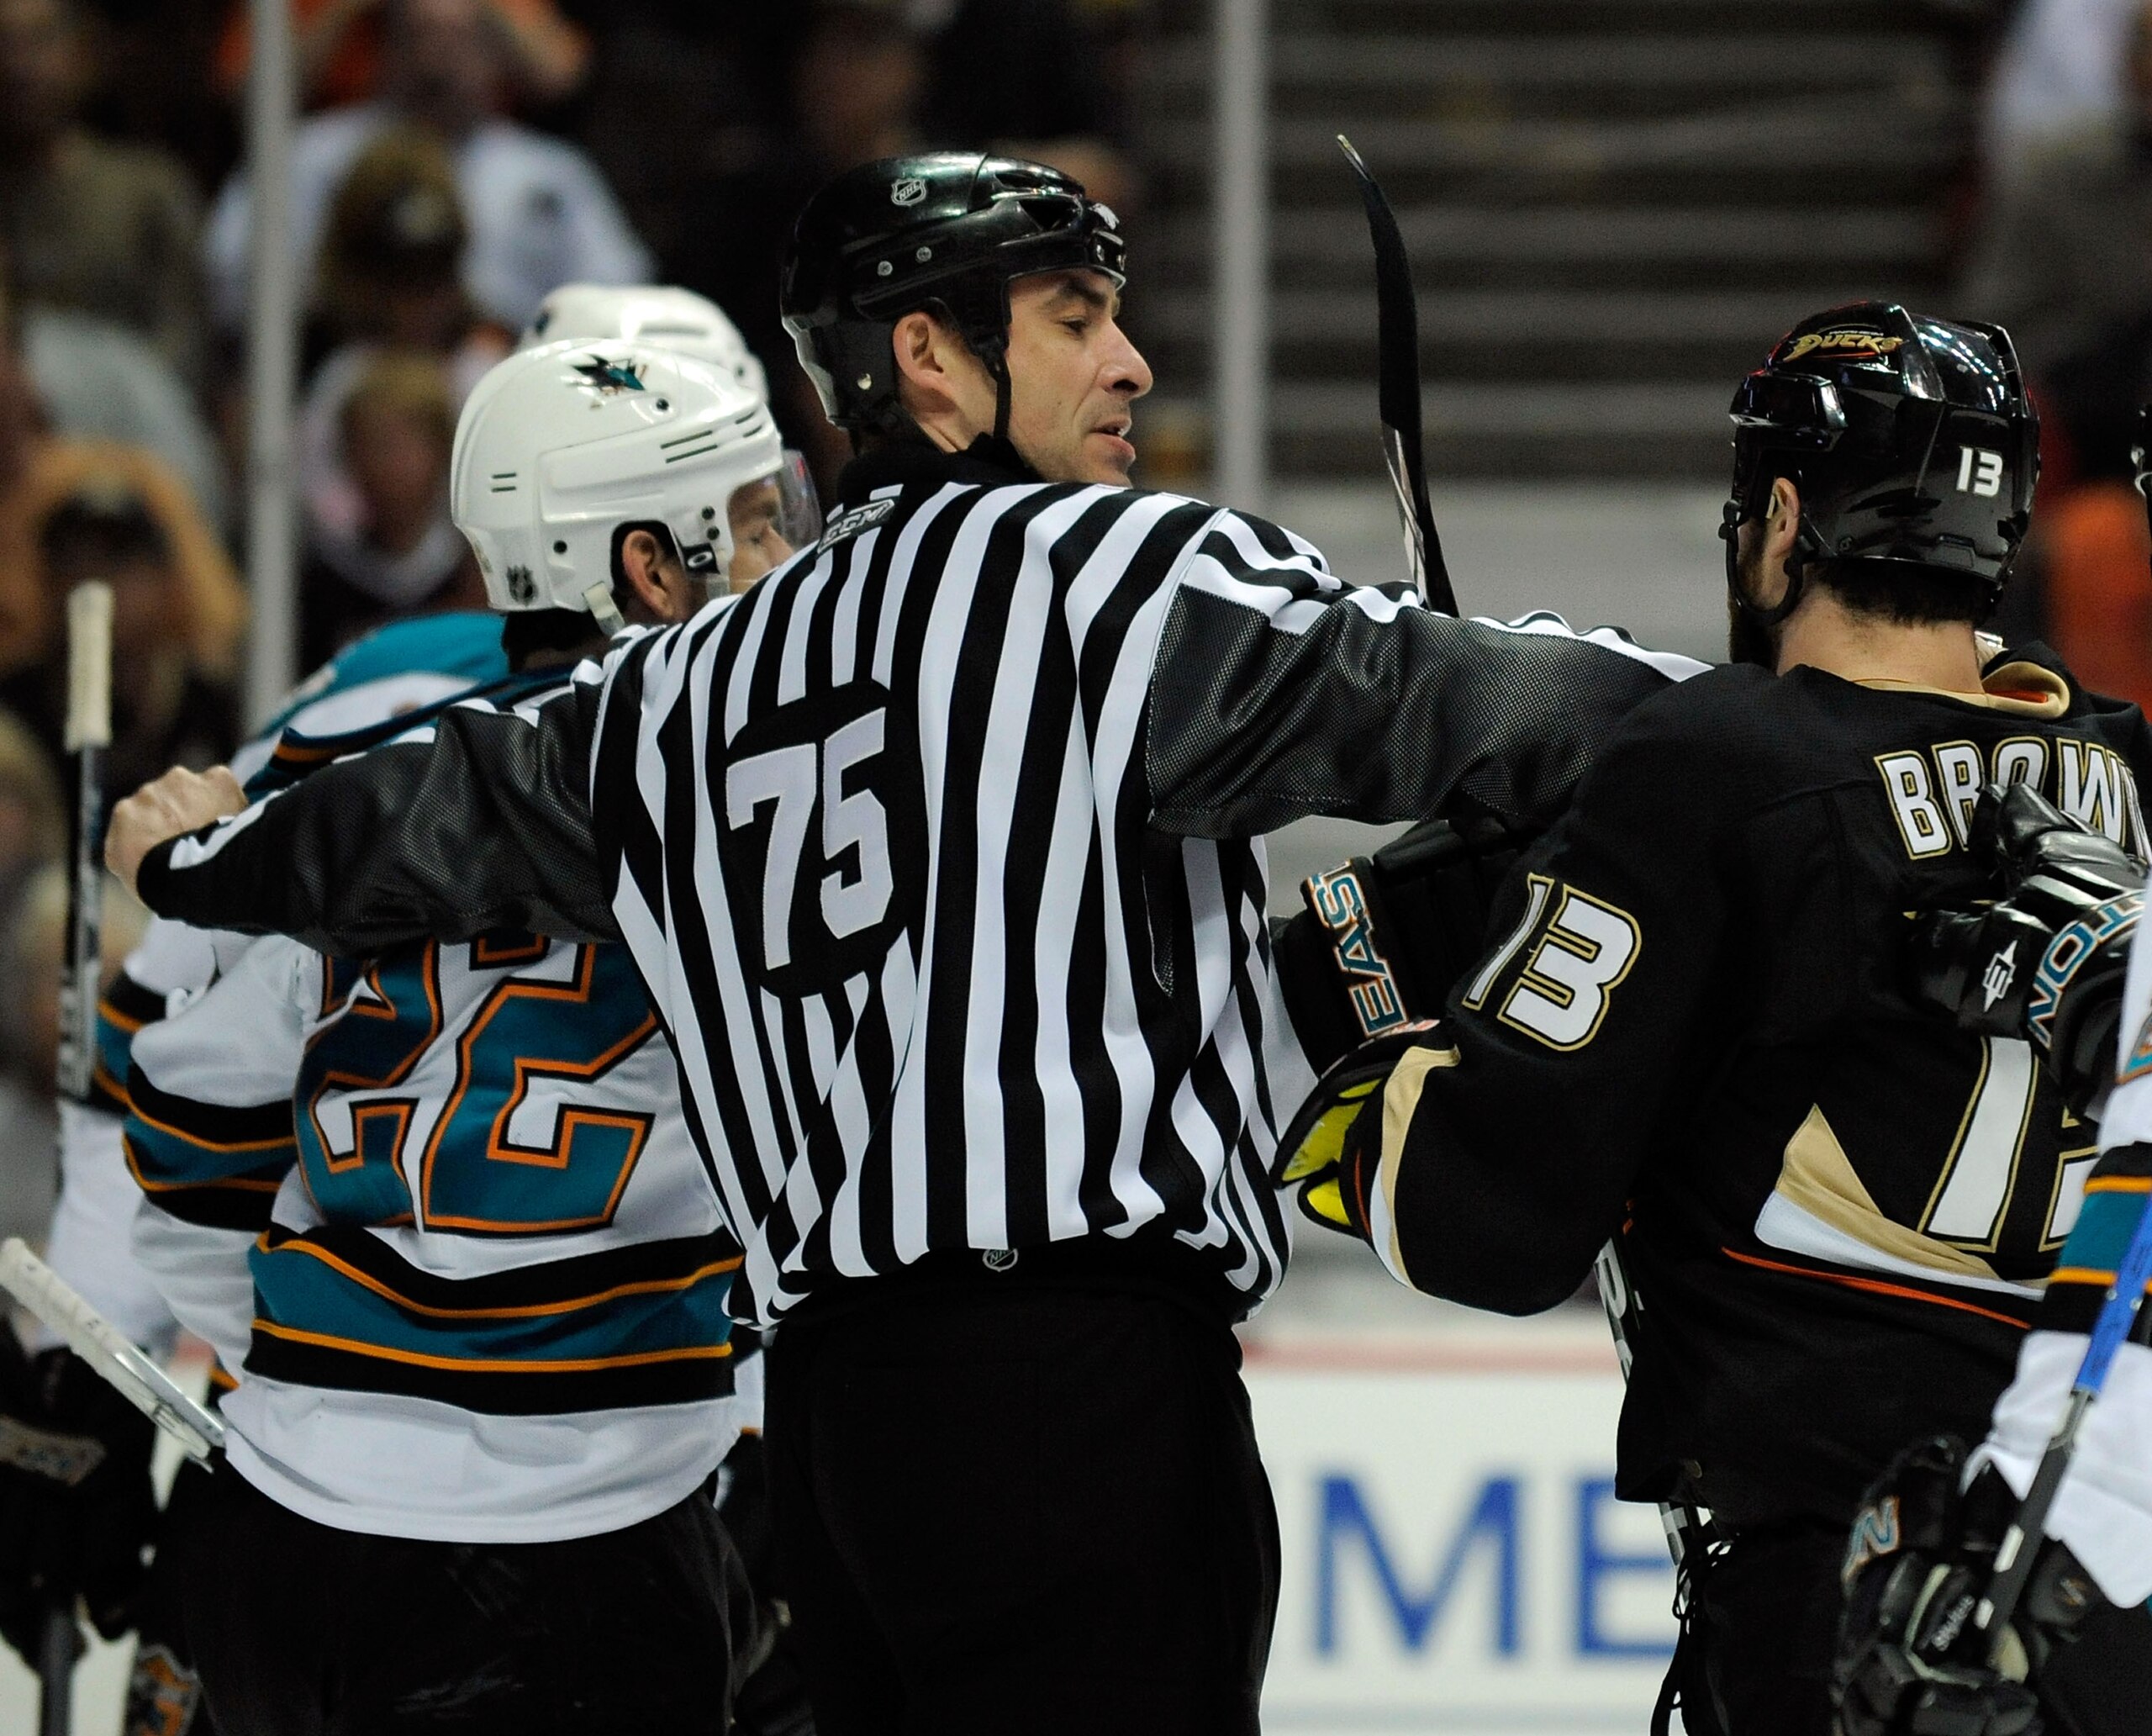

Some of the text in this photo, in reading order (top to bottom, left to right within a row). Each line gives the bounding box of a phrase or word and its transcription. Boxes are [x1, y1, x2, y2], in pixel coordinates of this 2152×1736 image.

[1783, 334, 1906, 362] DUCKS
[1956, 446, 2002, 497] 13
[726, 707, 894, 971] 75
[1309, 858, 1409, 1038] EAS
[1462, 873, 1642, 1052] 13
